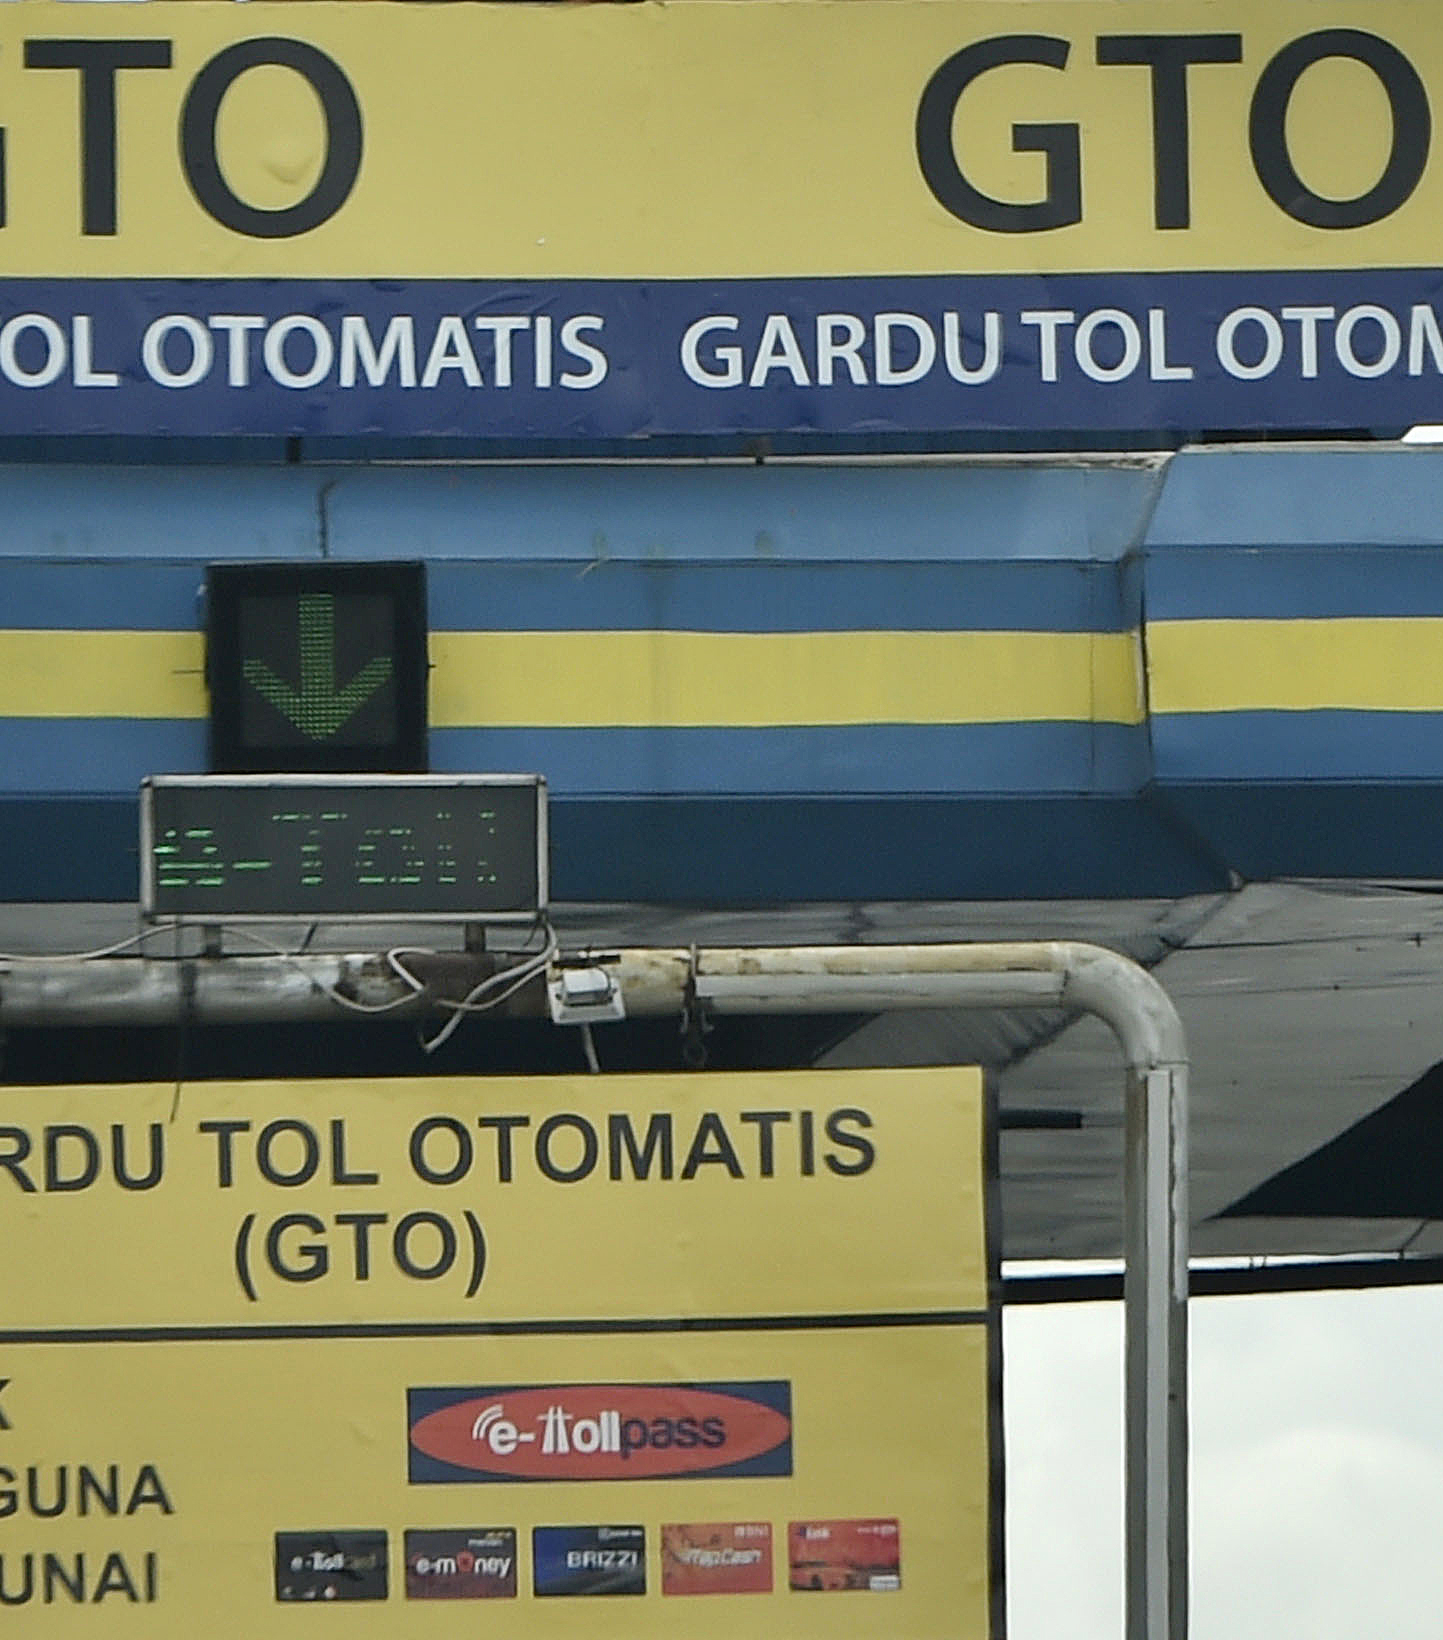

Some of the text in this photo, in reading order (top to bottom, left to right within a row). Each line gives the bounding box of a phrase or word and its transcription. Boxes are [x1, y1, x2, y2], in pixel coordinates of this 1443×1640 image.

[0, 36, 364, 240] TO
[915, 28, 1432, 234] GTO
[142, 315, 608, 389] OTOMATIS
[681, 312, 1000, 388] GARDU
[1020, 309, 1194, 382] TOL
[198, 1119, 380, 1189] TOL
[409, 1108, 876, 1186] OTOMATIS
[235, 1210, 486, 1302] (GTO)
[415, 1553, 512, 1578] e-money
[566, 1549, 639, 1570] BRIZZI
